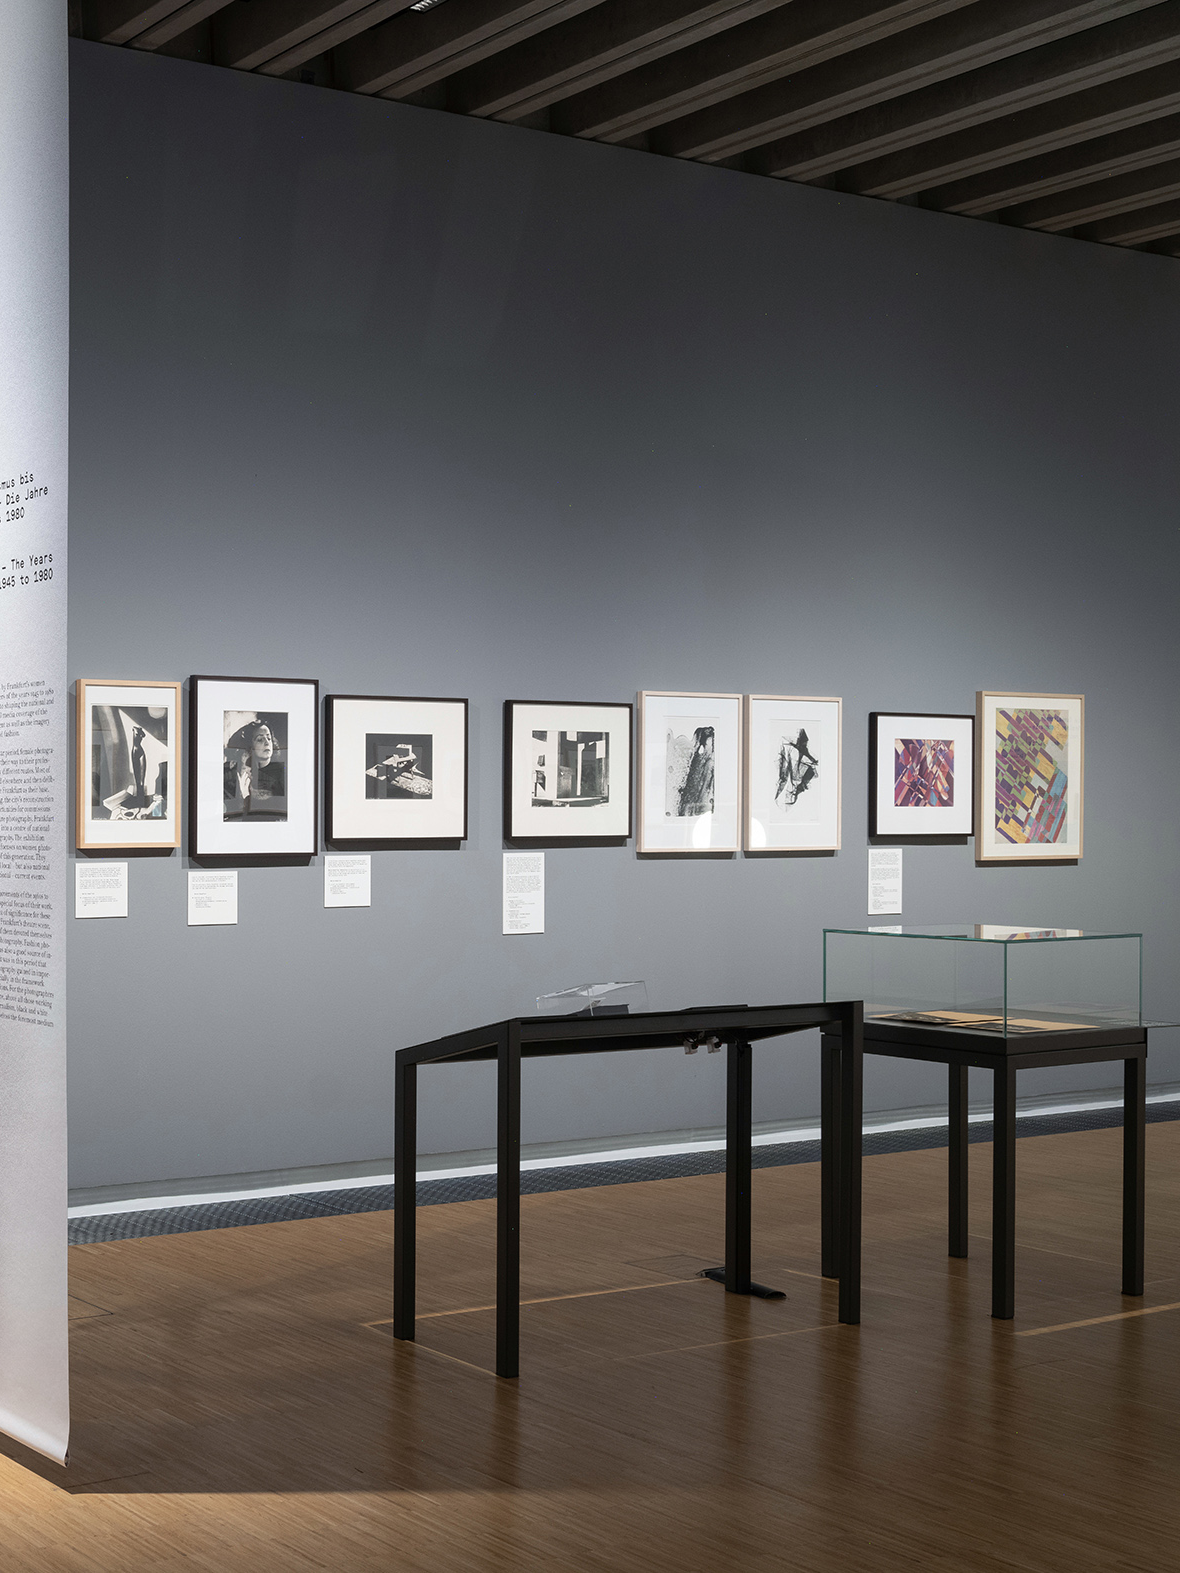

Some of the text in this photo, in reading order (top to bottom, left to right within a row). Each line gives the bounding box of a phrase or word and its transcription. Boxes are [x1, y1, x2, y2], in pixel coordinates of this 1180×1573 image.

[20, 472, 34, 485] bis
[6, 493, 20, 506] Die
[25, 485, 48, 500] Jahre
[6, 507, 25, 522] 1980
[11, 559, 25, 571] The
[29, 553, 53, 567] Years
[20, 574, 30, 585] to
[34, 568, 53, 583] 1980
